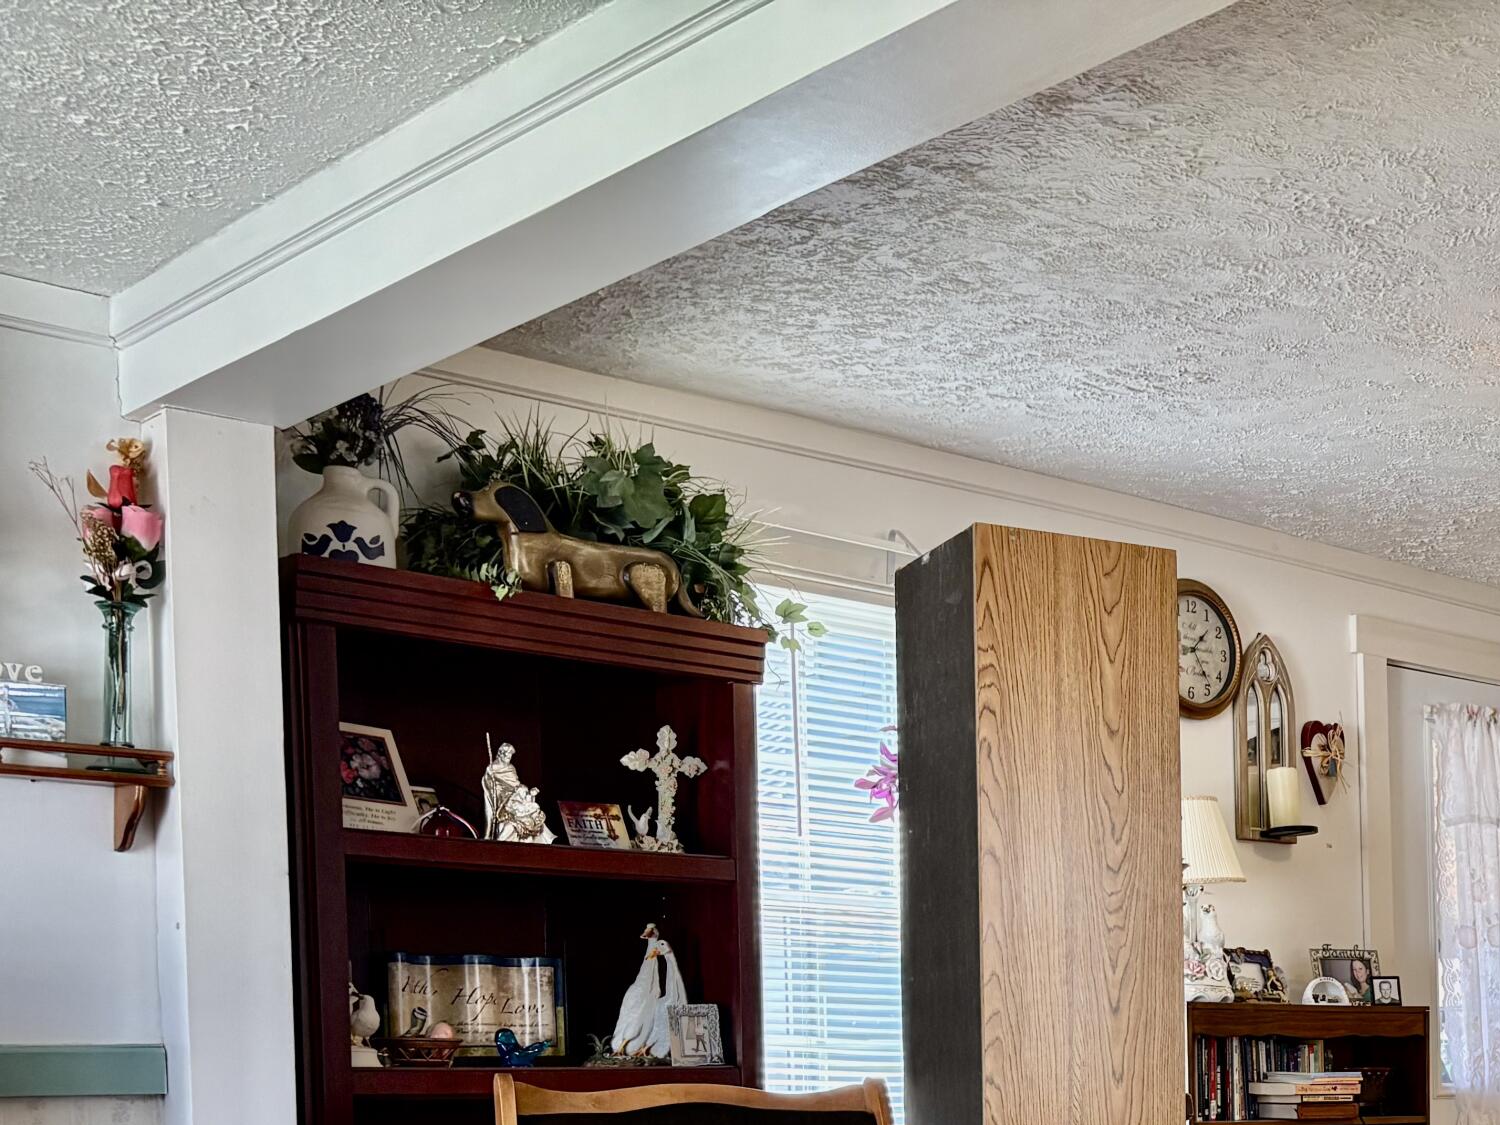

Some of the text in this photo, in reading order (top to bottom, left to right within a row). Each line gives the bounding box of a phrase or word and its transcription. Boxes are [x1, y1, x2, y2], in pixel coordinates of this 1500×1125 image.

[1186, 599, 1197, 614] 12
[1203, 609, 1210, 622] 1
[1215, 626, 1222, 640] 2
[1220, 650, 1227, 663] 3
[1215, 670, 1222, 683] 4
[1187, 686, 1195, 700] 6
[1204, 683, 1211, 697] 5
[566, 817, 604, 830] FAITH
